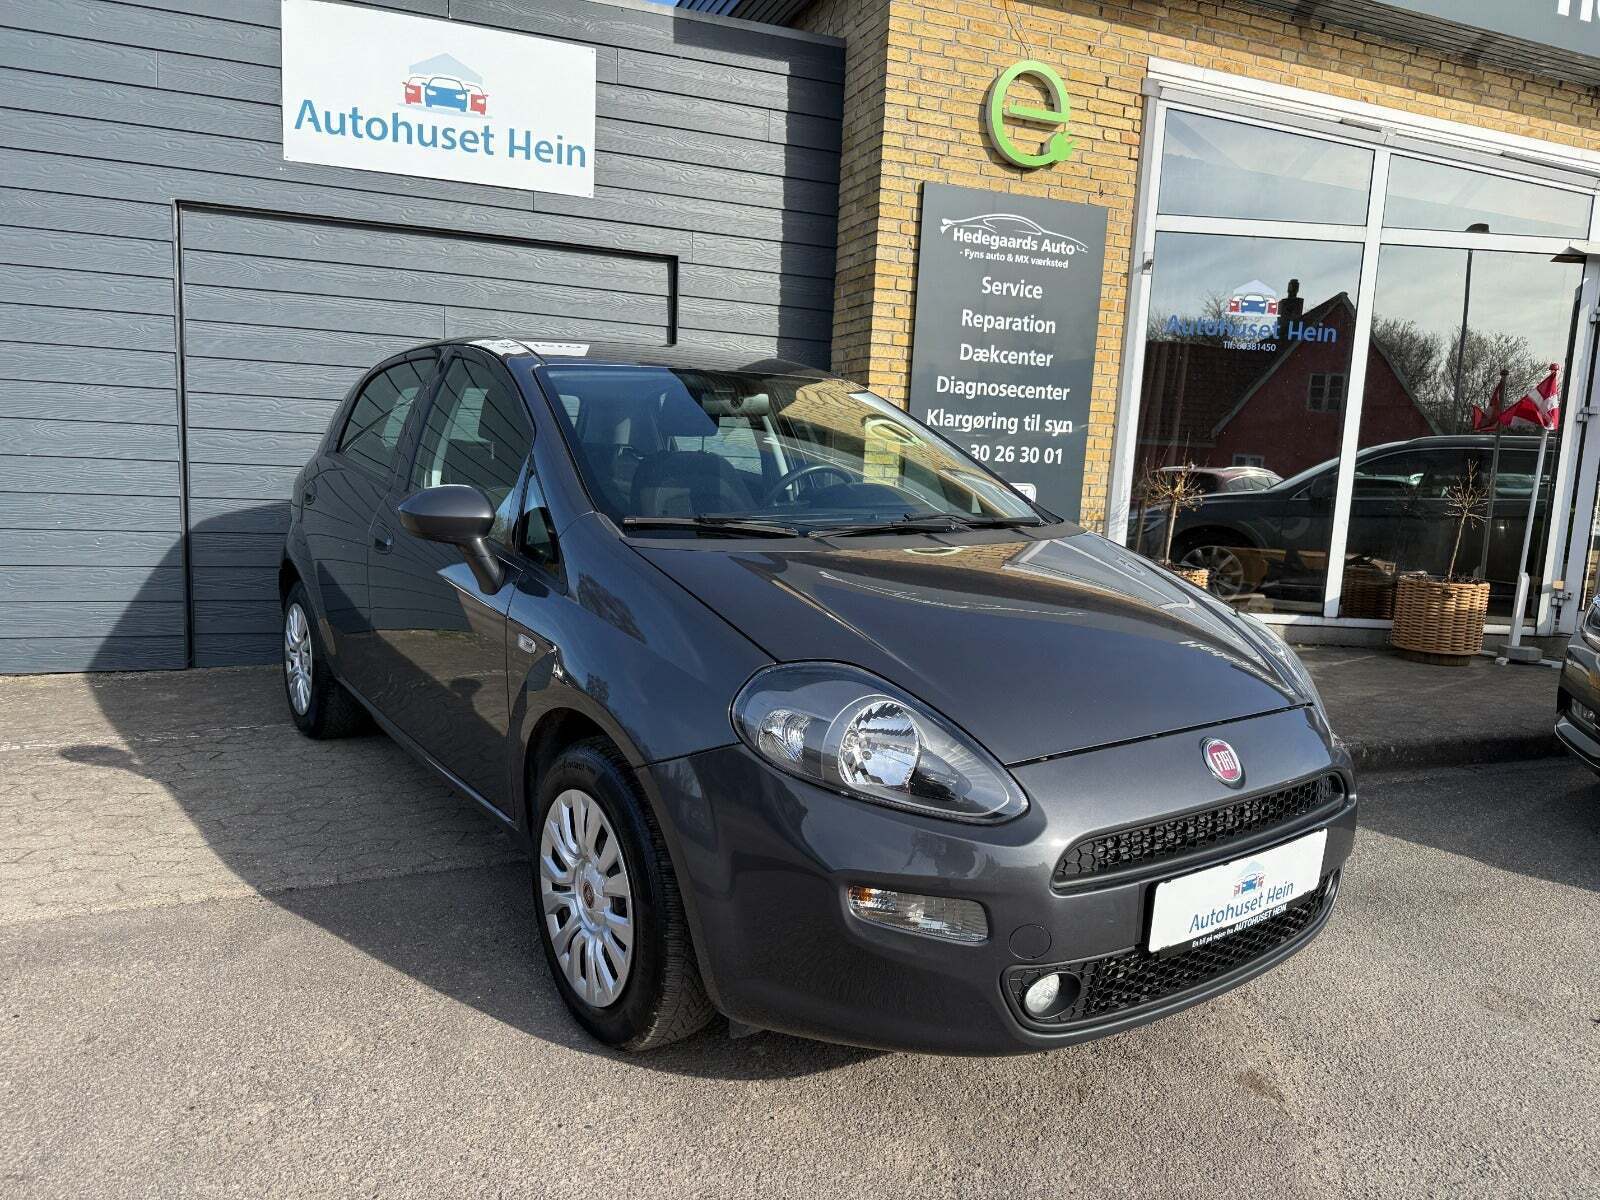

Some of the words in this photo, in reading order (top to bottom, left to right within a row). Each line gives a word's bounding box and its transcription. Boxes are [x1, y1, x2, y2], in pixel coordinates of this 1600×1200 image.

[295, 99, 494, 156] Autohuset
[508, 127, 586, 168] Hein
[953, 228, 1038, 250] Hedegaards
[1041, 239, 1075, 255] Auto
[964, 249, 985, 260] Fyns
[985, 252, 1005, 262] auto
[1006, 254, 1014, 262] &
[1014, 254, 1029, 264] MX
[1030, 256, 1069, 269] værksted
[981, 276, 1043, 299] Service
[961, 308, 1056, 334] Reparation
[1164, 315, 1280, 339] Autohuset
[1288, 321, 1337, 343] Hein
[959, 343, 1054, 367] Dækcenter
[936, 375, 1071, 401] Diagnosecenter
[926, 408, 1019, 435] Klargøring
[1023, 413, 1041, 432] til
[1045, 419, 1073, 437] syn
[994, 446, 1015, 463] 26
[1019, 447, 1040, 464] 30
[1044, 448, 1063, 465] 01
[1212, 750, 1236, 772] FIAT
[1189, 892, 1264, 934] Autohuset
[1266, 881, 1293, 904] Hein
[1234, 909, 1272, 932] AUTOHUSET
[1272, 903, 1287, 917] HEIN
